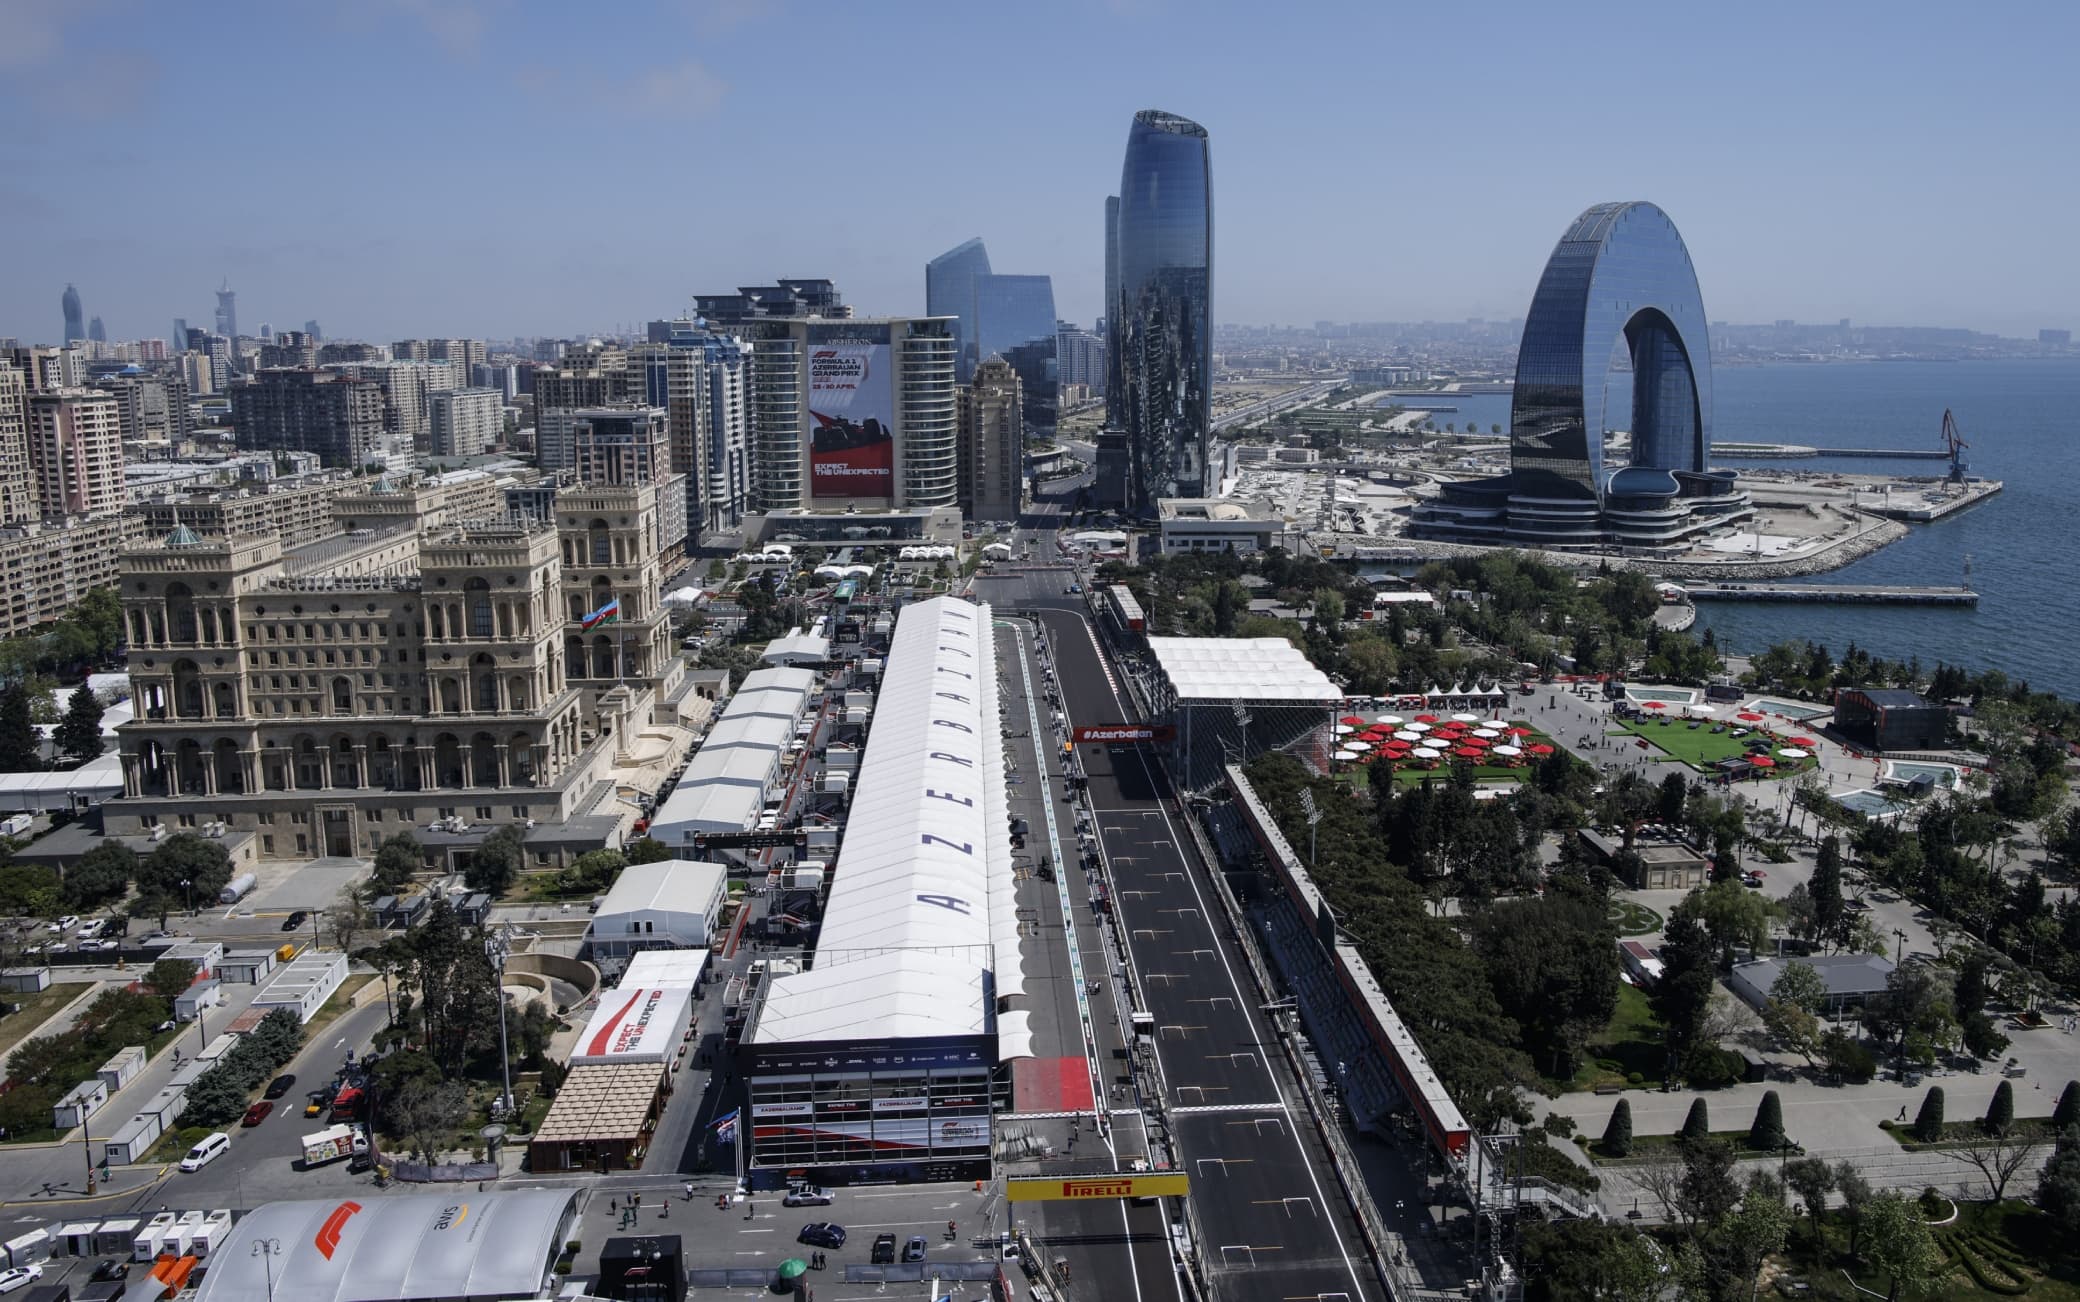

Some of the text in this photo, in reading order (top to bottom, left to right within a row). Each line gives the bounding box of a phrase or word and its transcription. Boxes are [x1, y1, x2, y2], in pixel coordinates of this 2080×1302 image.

[613, 1024, 635, 1052] EXPECT
[624, 1036, 642, 1052] THE
[1063, 1180, 1132, 1197] PIRELLI
[433, 1206, 459, 1230] aws
